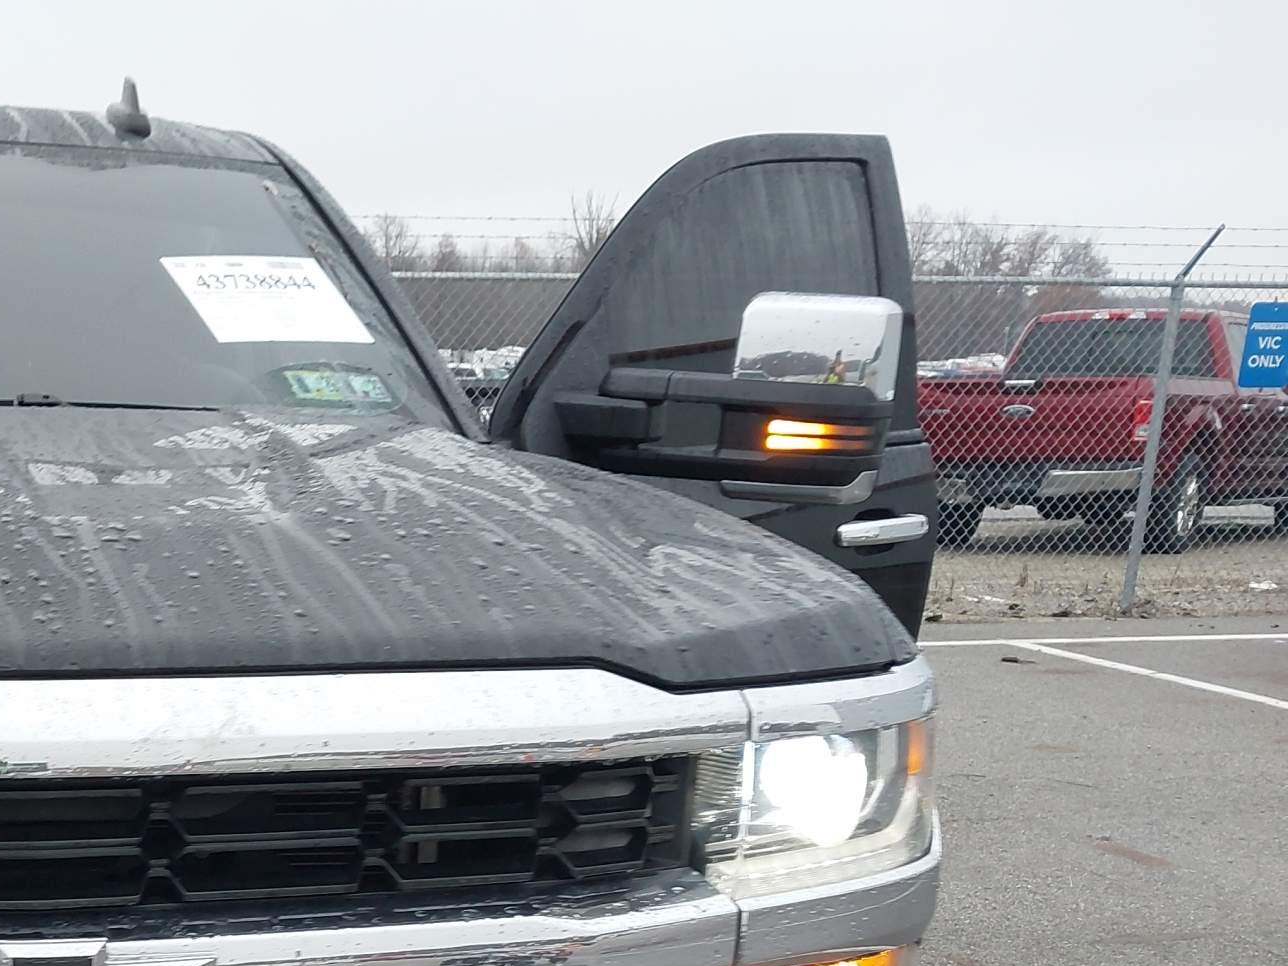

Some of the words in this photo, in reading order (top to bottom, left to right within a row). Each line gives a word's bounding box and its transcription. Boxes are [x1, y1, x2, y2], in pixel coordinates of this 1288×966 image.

[196, 273, 316, 290] 43738844
[1258, 336, 1282, 349] VIC
[1247, 355, 1285, 368] ONLY
